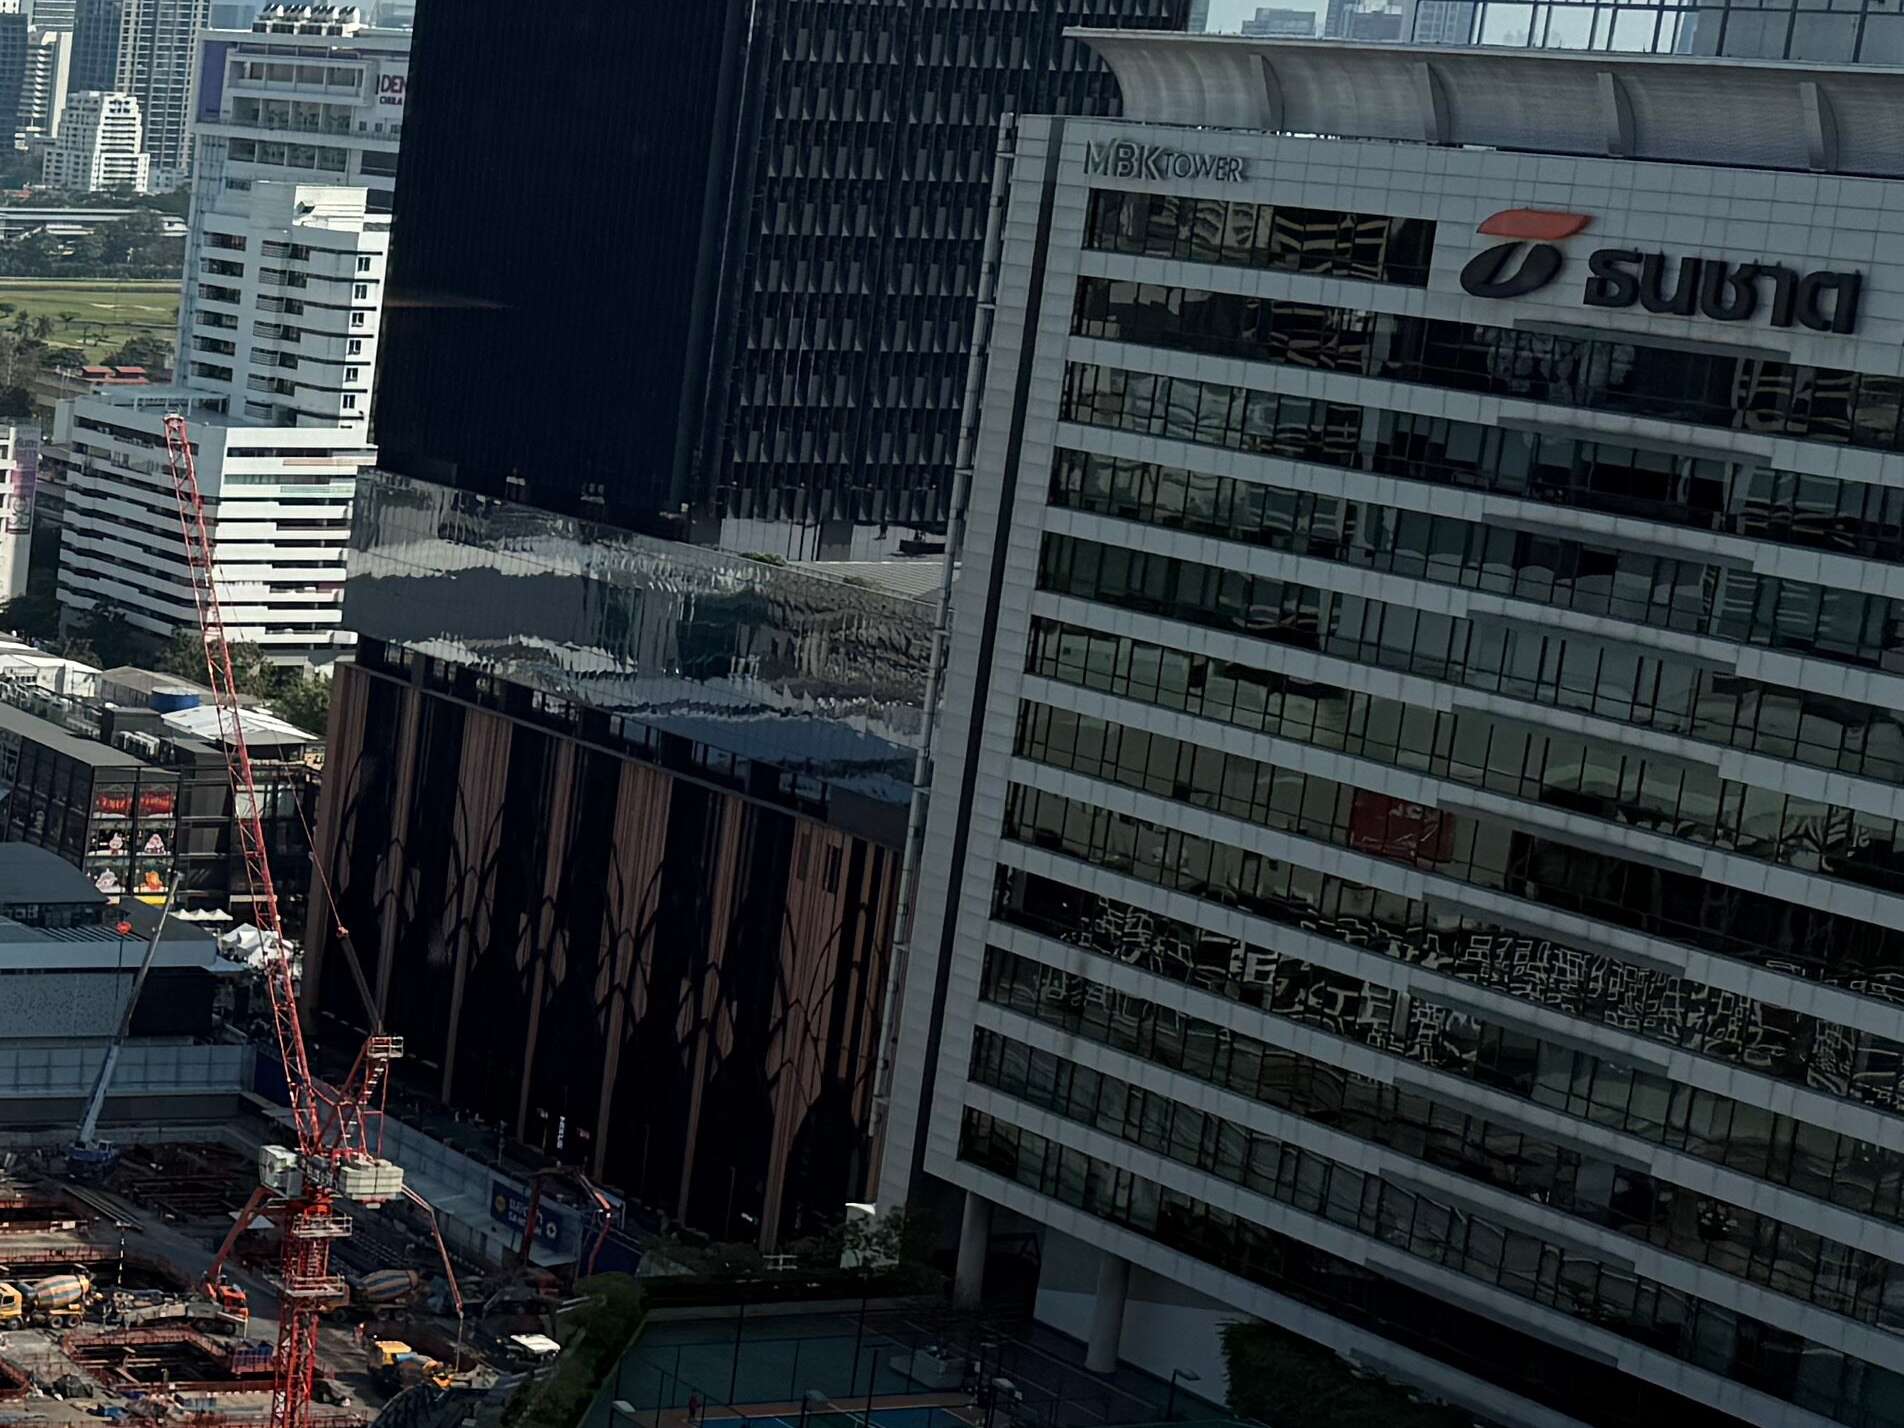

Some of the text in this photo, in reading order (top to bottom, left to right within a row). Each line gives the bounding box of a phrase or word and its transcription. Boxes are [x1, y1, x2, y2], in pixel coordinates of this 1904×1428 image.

[1083, 138, 1243, 182] MBK TOWER
[1583, 246, 1863, 335] ธนชาต
